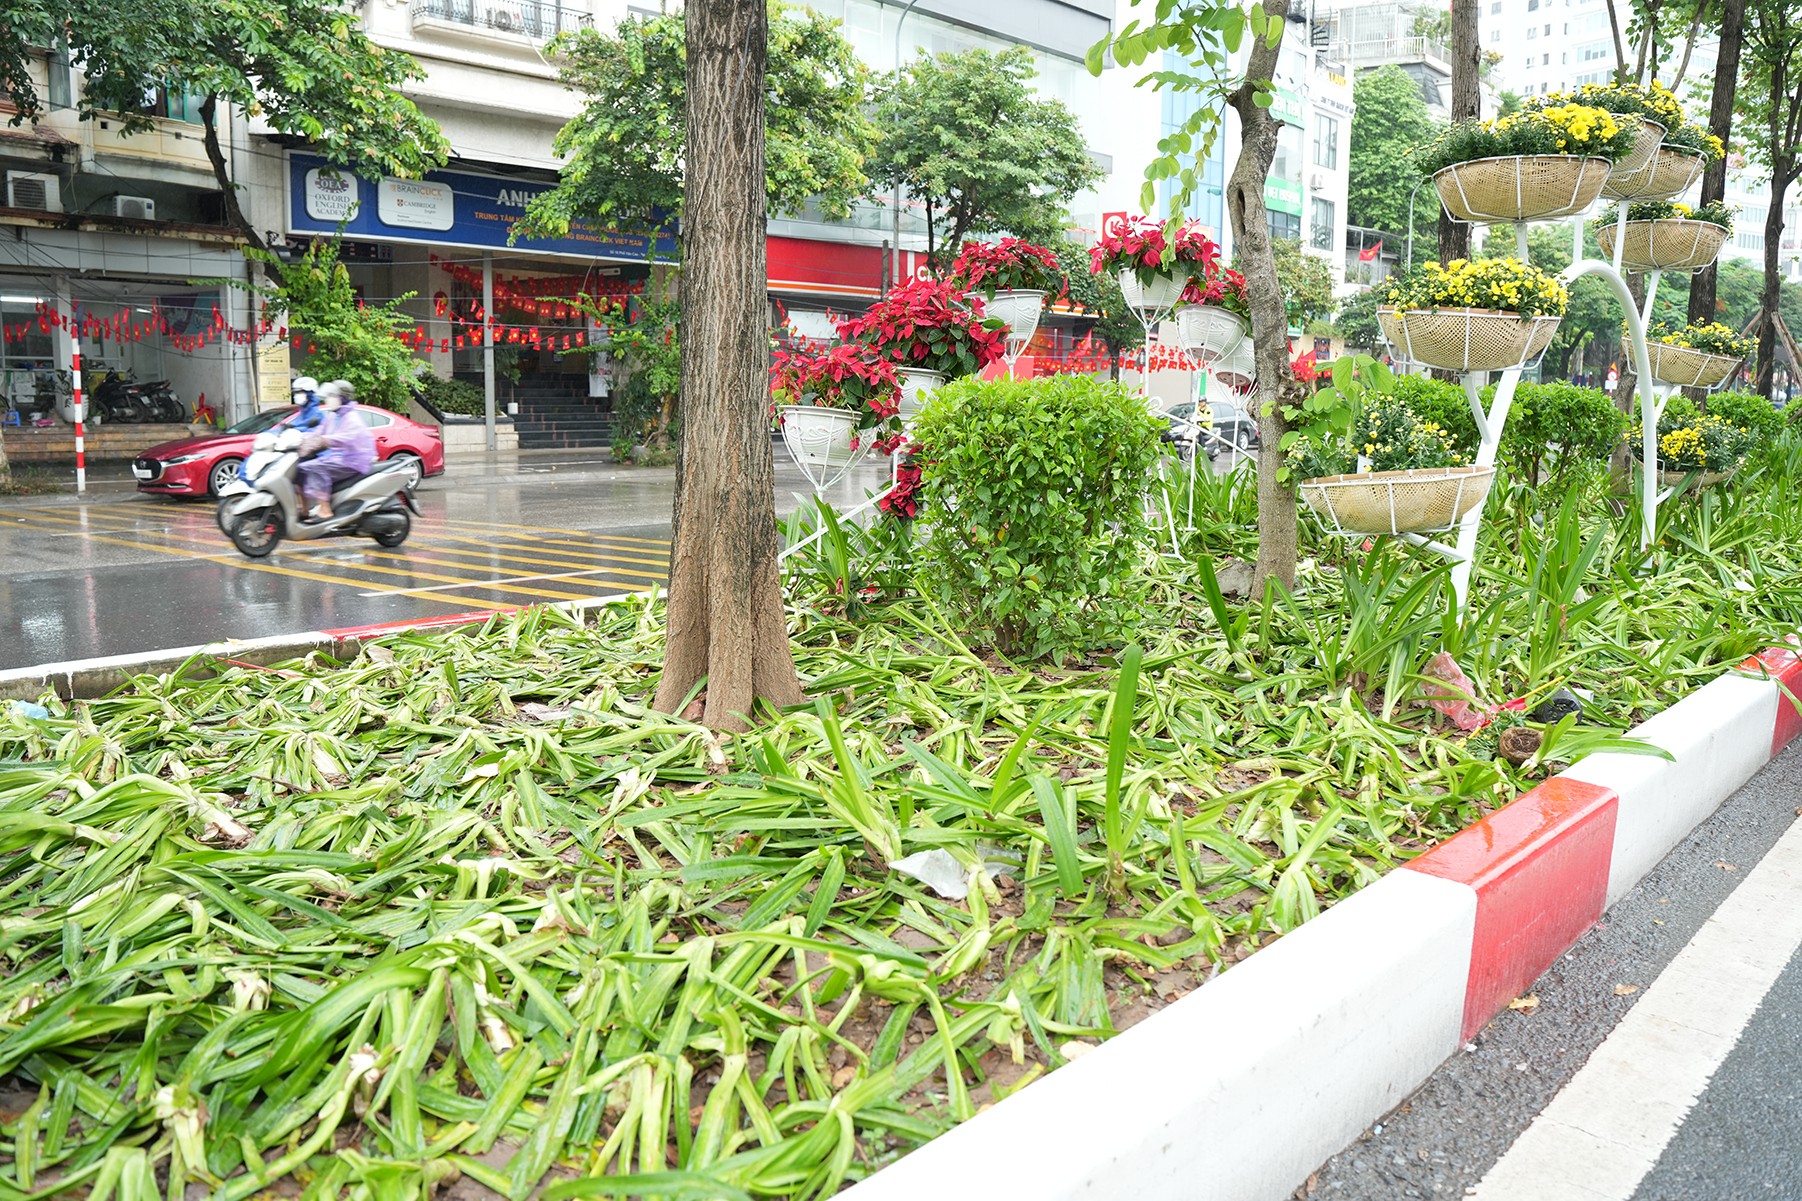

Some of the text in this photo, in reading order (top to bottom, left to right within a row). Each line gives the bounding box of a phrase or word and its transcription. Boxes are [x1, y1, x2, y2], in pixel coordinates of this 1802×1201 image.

[396, 184, 442, 197] BRAINCLICK
[314, 193, 350, 202] OXFORD
[315, 200, 350, 210] ENGLISH
[404, 201, 436, 209] CAMBRIDGE
[474, 211, 498, 221] TRUNG
[500, 213, 515, 222] TÂM
